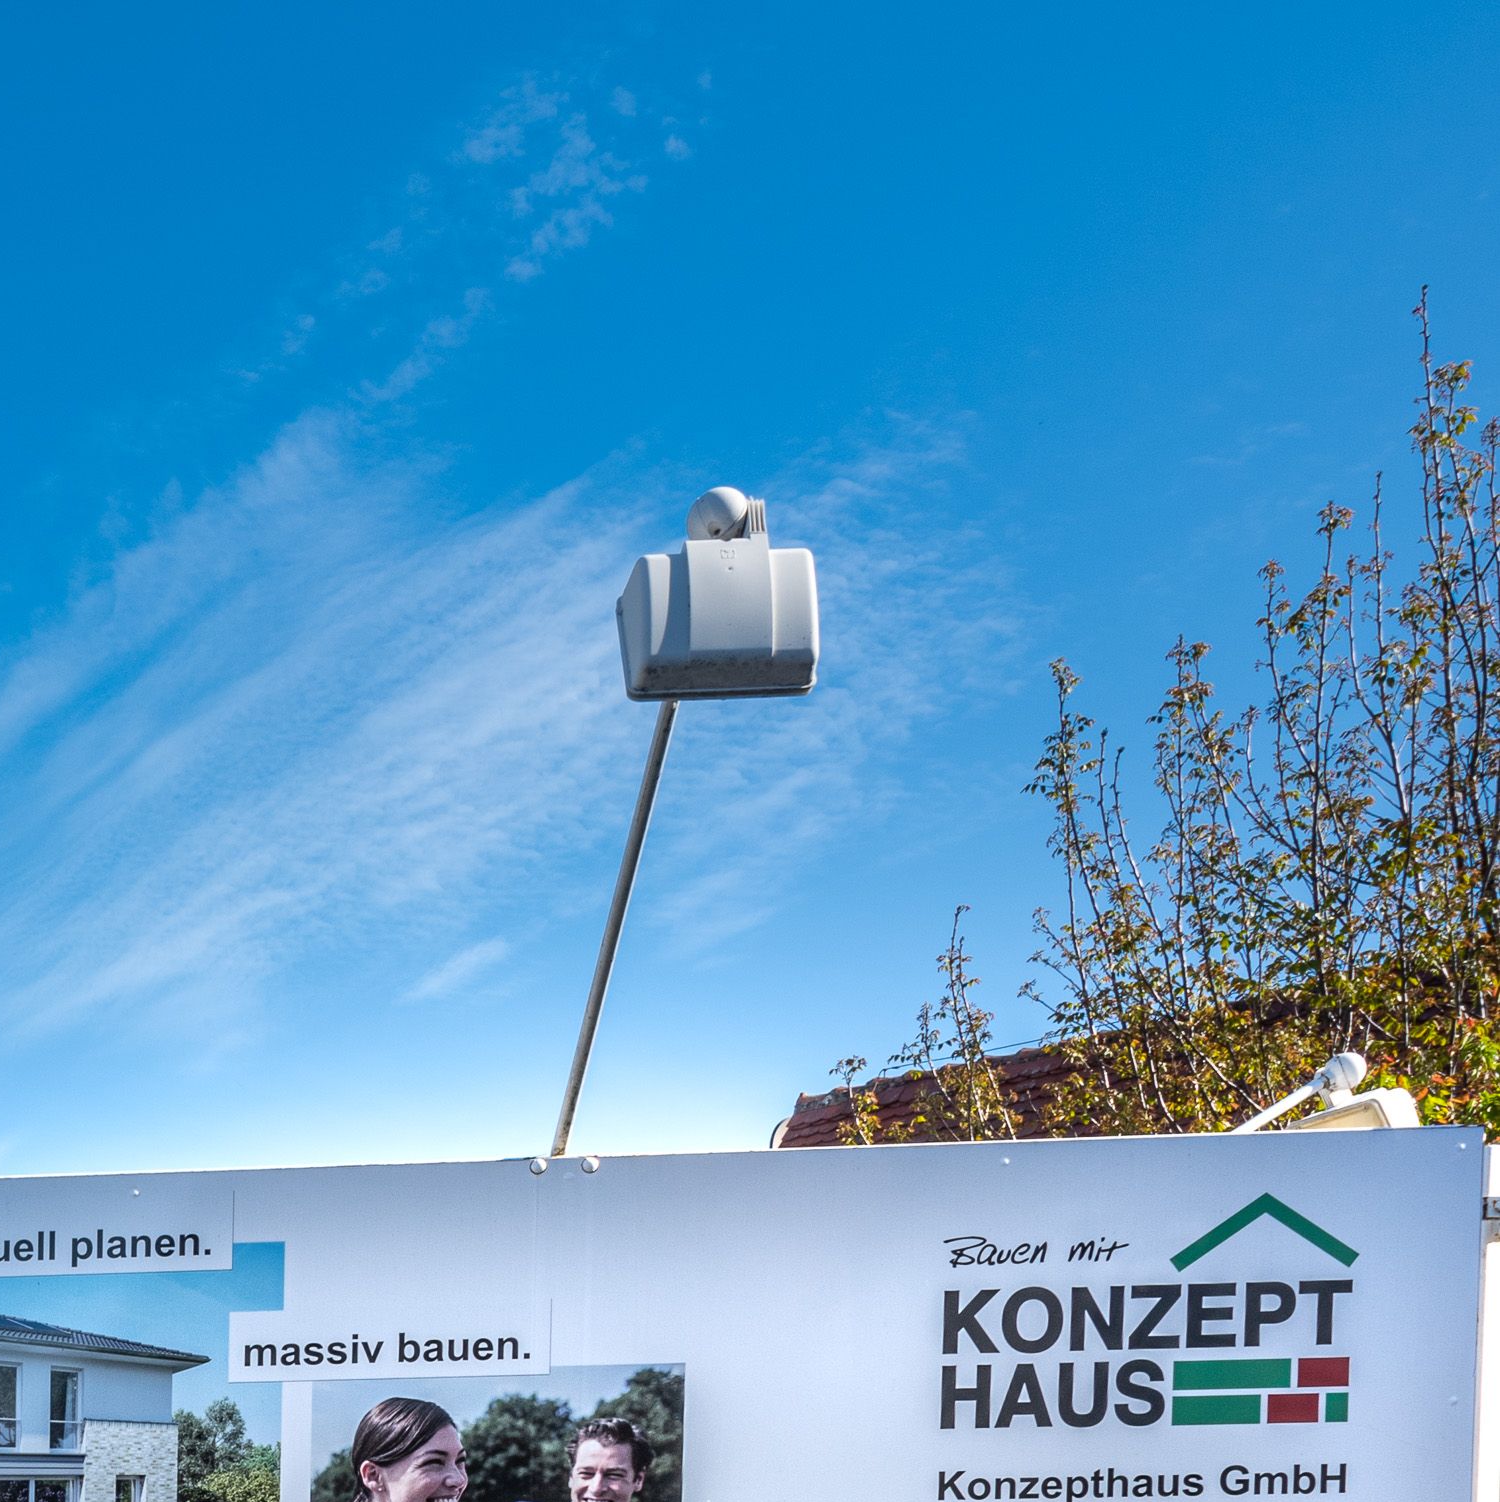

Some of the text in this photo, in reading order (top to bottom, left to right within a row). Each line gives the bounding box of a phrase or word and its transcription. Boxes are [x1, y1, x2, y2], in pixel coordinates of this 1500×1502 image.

[70, 1228, 212, 1268] planen.
[943, 1235, 1130, 1269] Bauen mit
[942, 1279, 1354, 1356] KONZEPT
[243, 1330, 532, 1368] massiv bauen.
[940, 1359, 1166, 1430] HAUS
[1218, 1463, 1348, 1497] GmbH
